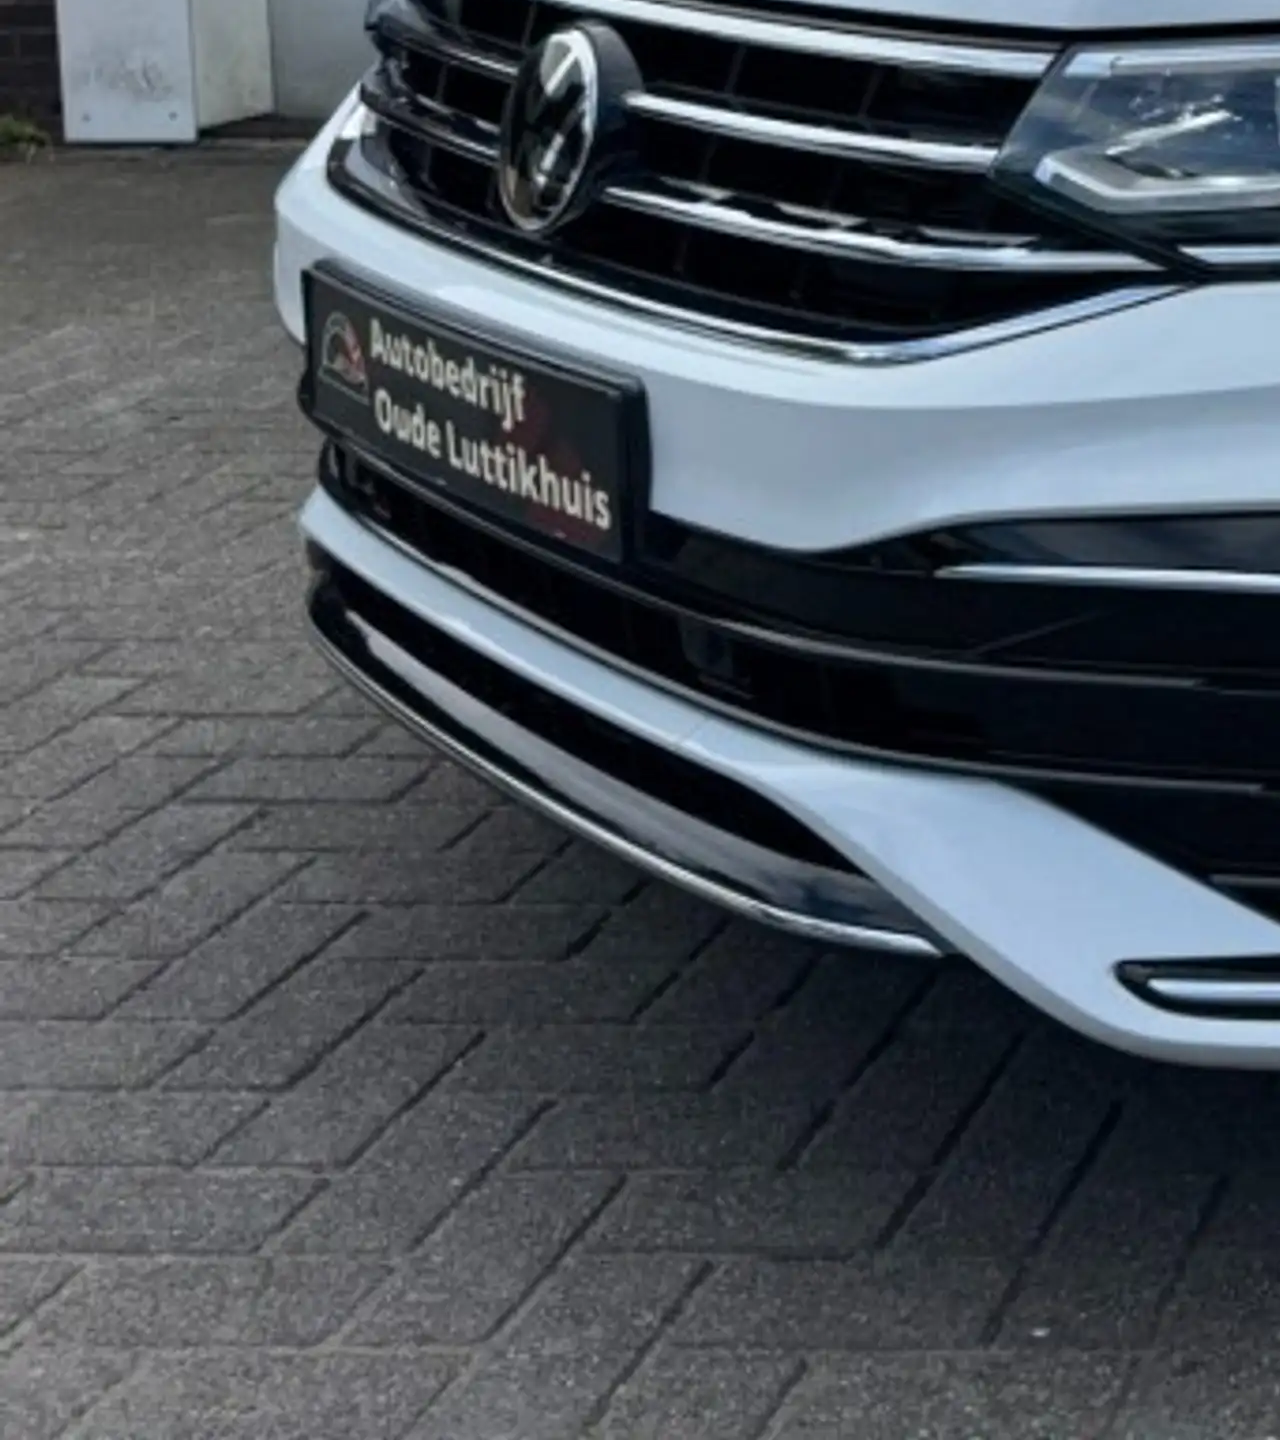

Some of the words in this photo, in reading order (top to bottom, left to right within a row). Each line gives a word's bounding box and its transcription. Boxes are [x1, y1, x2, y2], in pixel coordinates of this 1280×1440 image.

[369, 317, 527, 432] Autobedrijf
[373, 388, 442, 459] Oude
[445, 419, 611, 531] Luttikhuis
